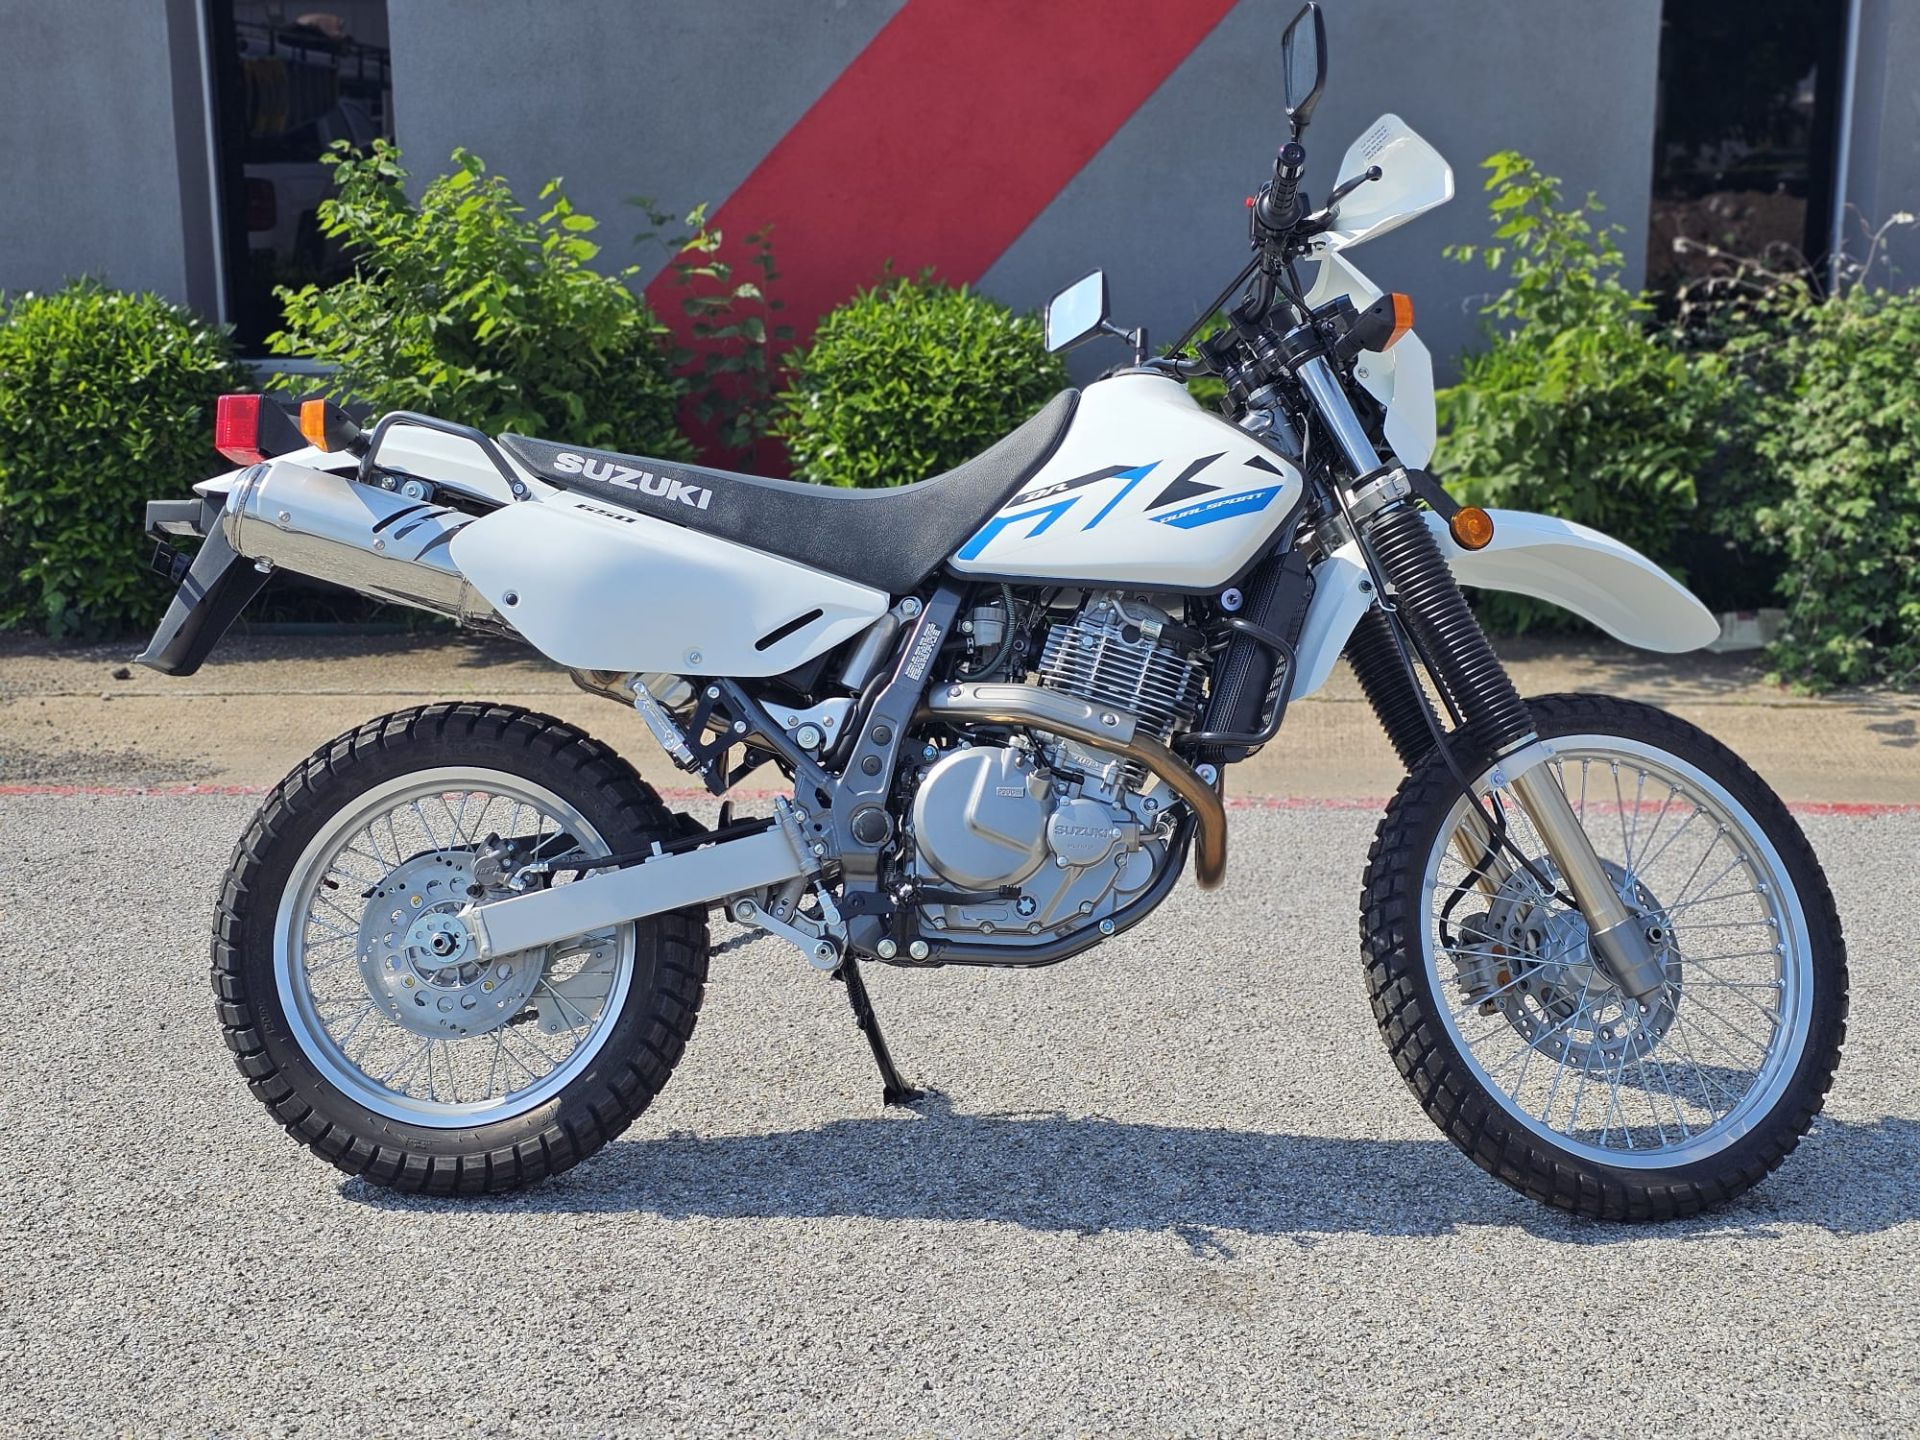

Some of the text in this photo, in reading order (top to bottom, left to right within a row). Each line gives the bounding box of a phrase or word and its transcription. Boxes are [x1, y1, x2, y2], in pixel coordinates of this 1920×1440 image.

[553, 452, 713, 510] SUZUKI
[1023, 482, 1069, 502] DR
[1205, 492, 1266, 510] SPORT
[573, 504, 637, 523] 650
[1053, 824, 1111, 839] SUZUKI
